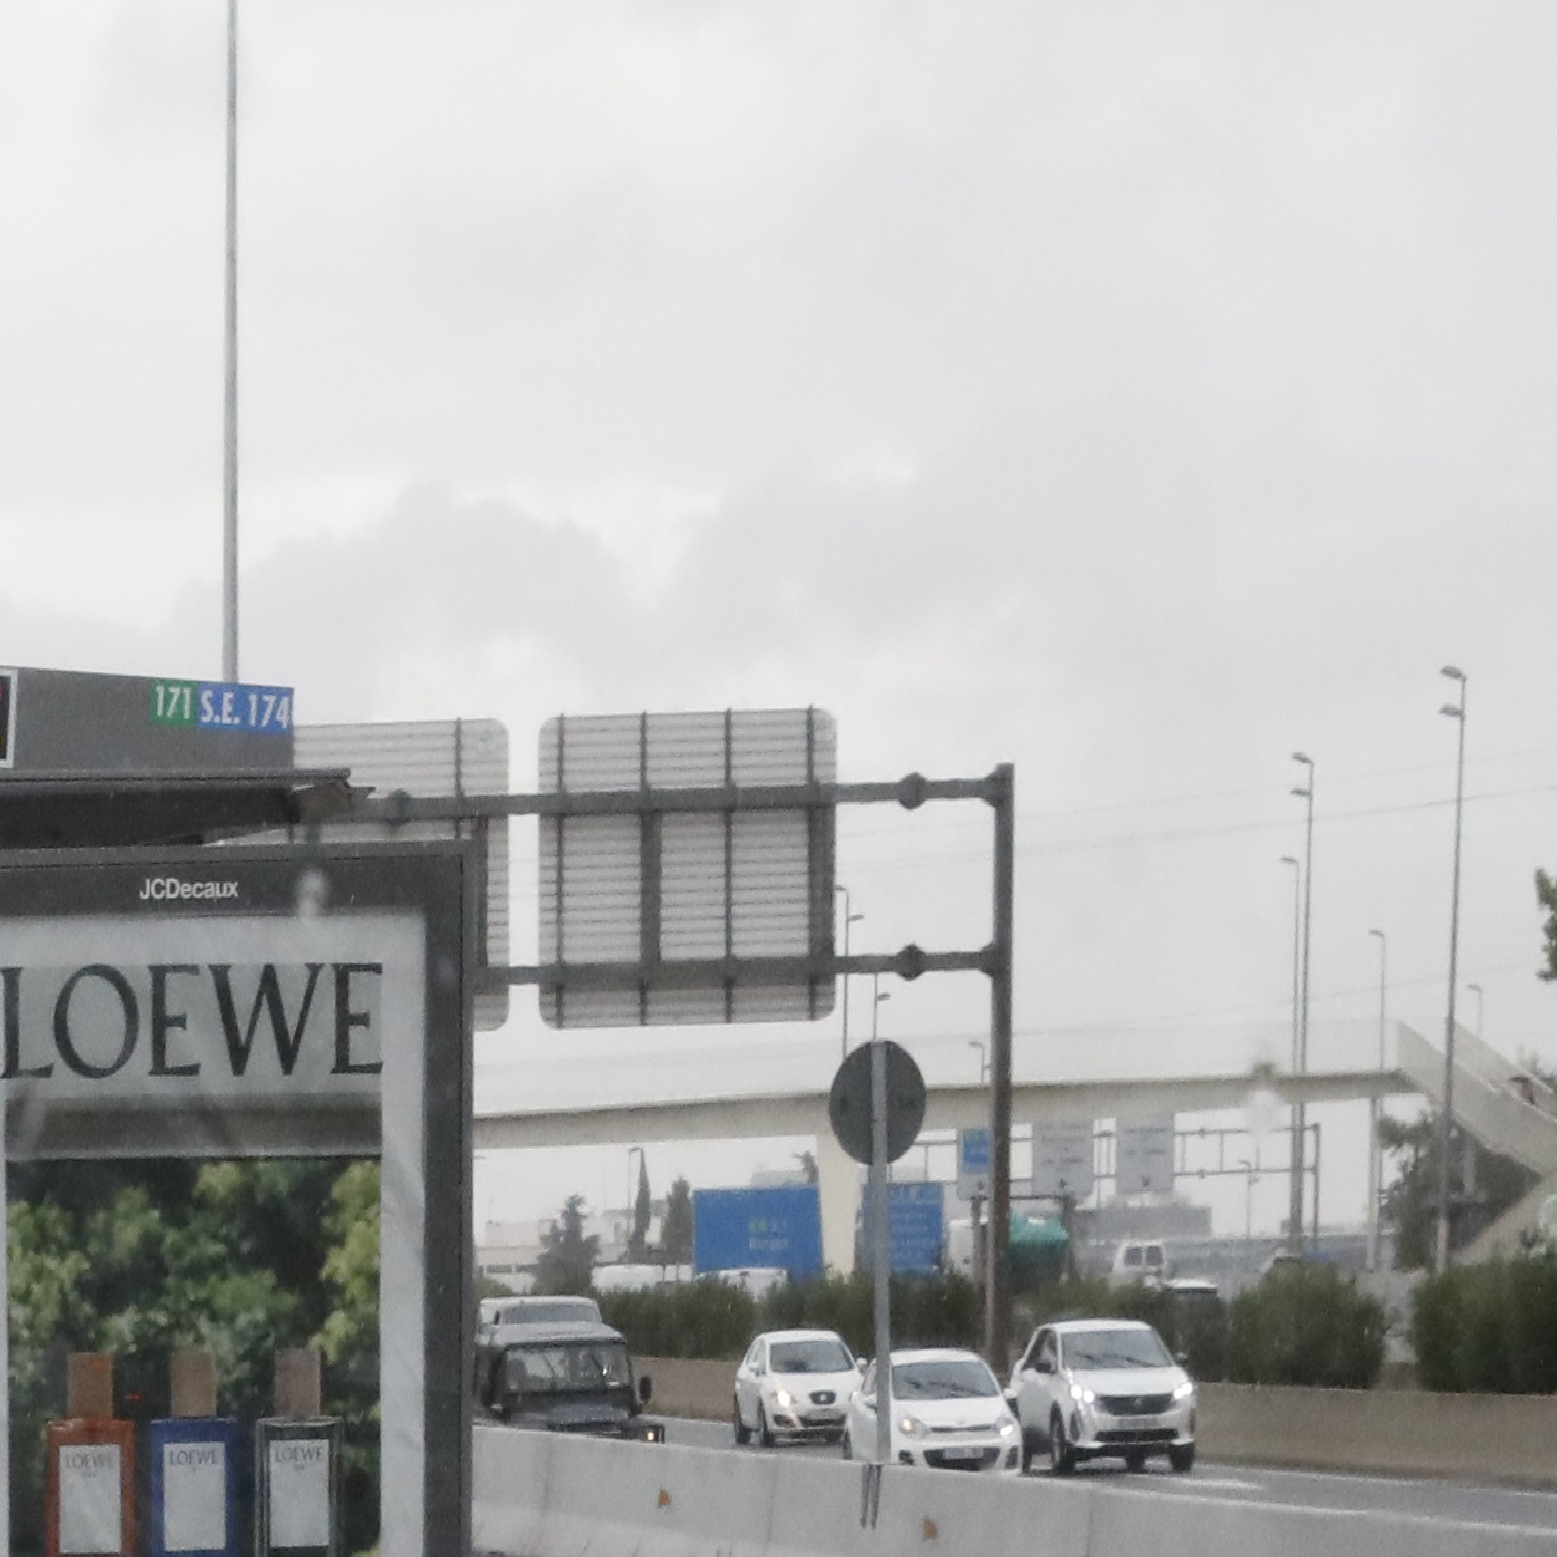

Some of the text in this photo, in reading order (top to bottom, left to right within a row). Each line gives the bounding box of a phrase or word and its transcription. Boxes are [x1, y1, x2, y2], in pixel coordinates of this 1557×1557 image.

[155, 685, 290, 729] 171 S.E. 174
[139, 878, 239, 900] JCDecaux
